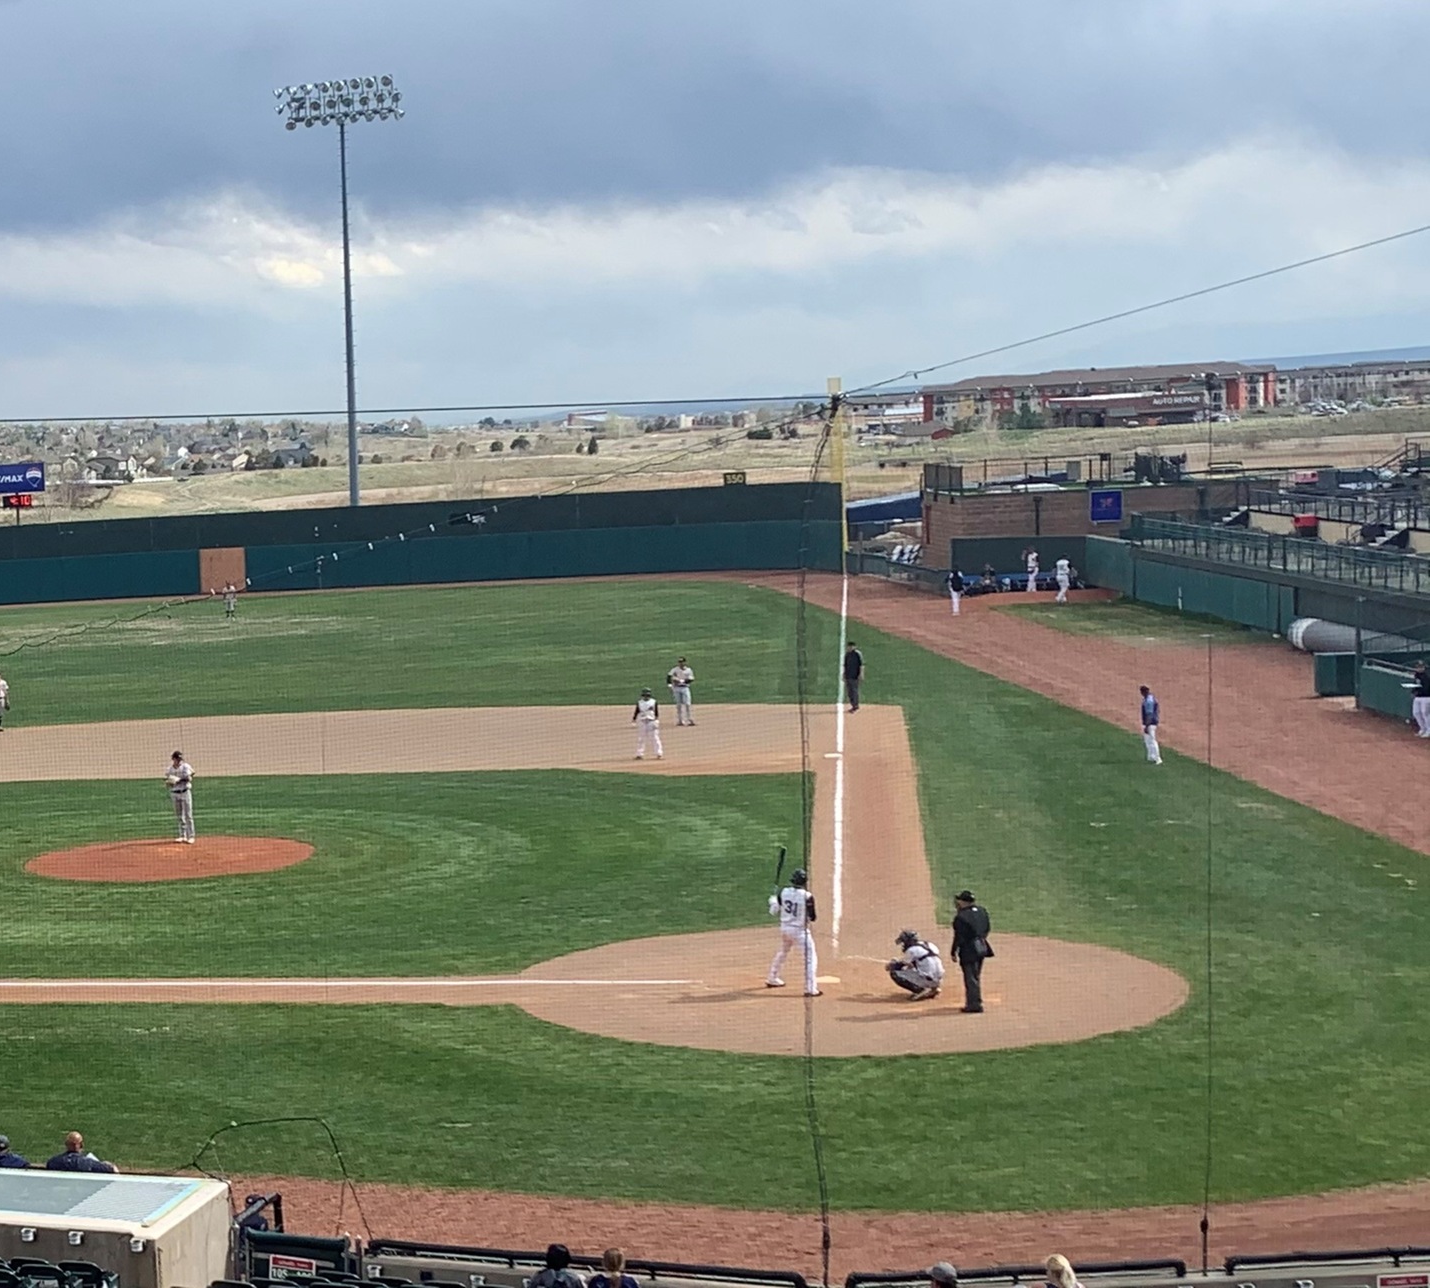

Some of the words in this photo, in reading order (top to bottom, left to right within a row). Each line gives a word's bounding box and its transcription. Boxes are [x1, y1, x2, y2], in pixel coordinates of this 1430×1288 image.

[1152, 397, 1173, 405] AUTO
[1173, 395, 1200, 404] REPAIR
[725, 474, 744, 484] 350
[784, 900, 798, 917] 31
